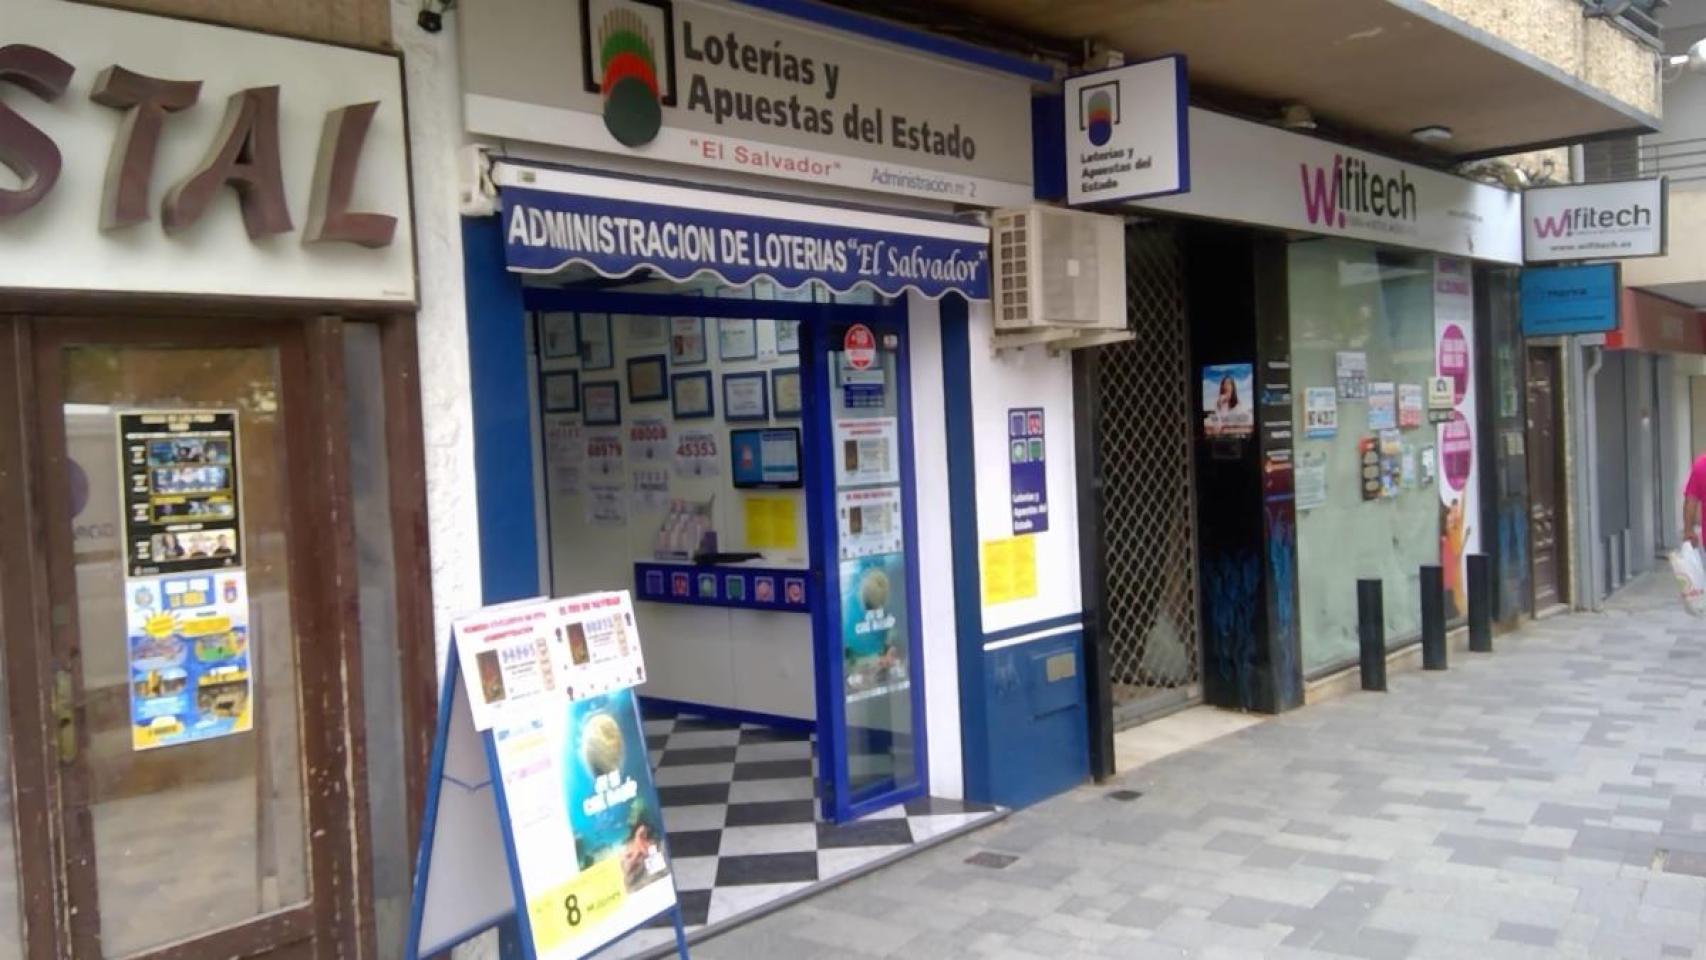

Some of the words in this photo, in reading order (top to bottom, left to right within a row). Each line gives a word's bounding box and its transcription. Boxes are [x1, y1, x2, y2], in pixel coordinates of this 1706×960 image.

[682, 20, 815, 86] Loterías
[823, 62, 840, 100] y
[687, 73, 834, 125] Apuestas
[843, 103, 883, 145] del
[891, 115, 976, 161] Estado
[1082, 162, 1131, 179] Apuestas
[1135, 156, 1152, 171] del
[968, 181, 977, 198] 2
[1081, 178, 1118, 193] Estado
[508, 204, 716, 264] ADMINISTRACION
[720, 228, 750, 265] DE
[754, 232, 848, 273] LOTERIAS
[565, 893, 581, 926] 8
